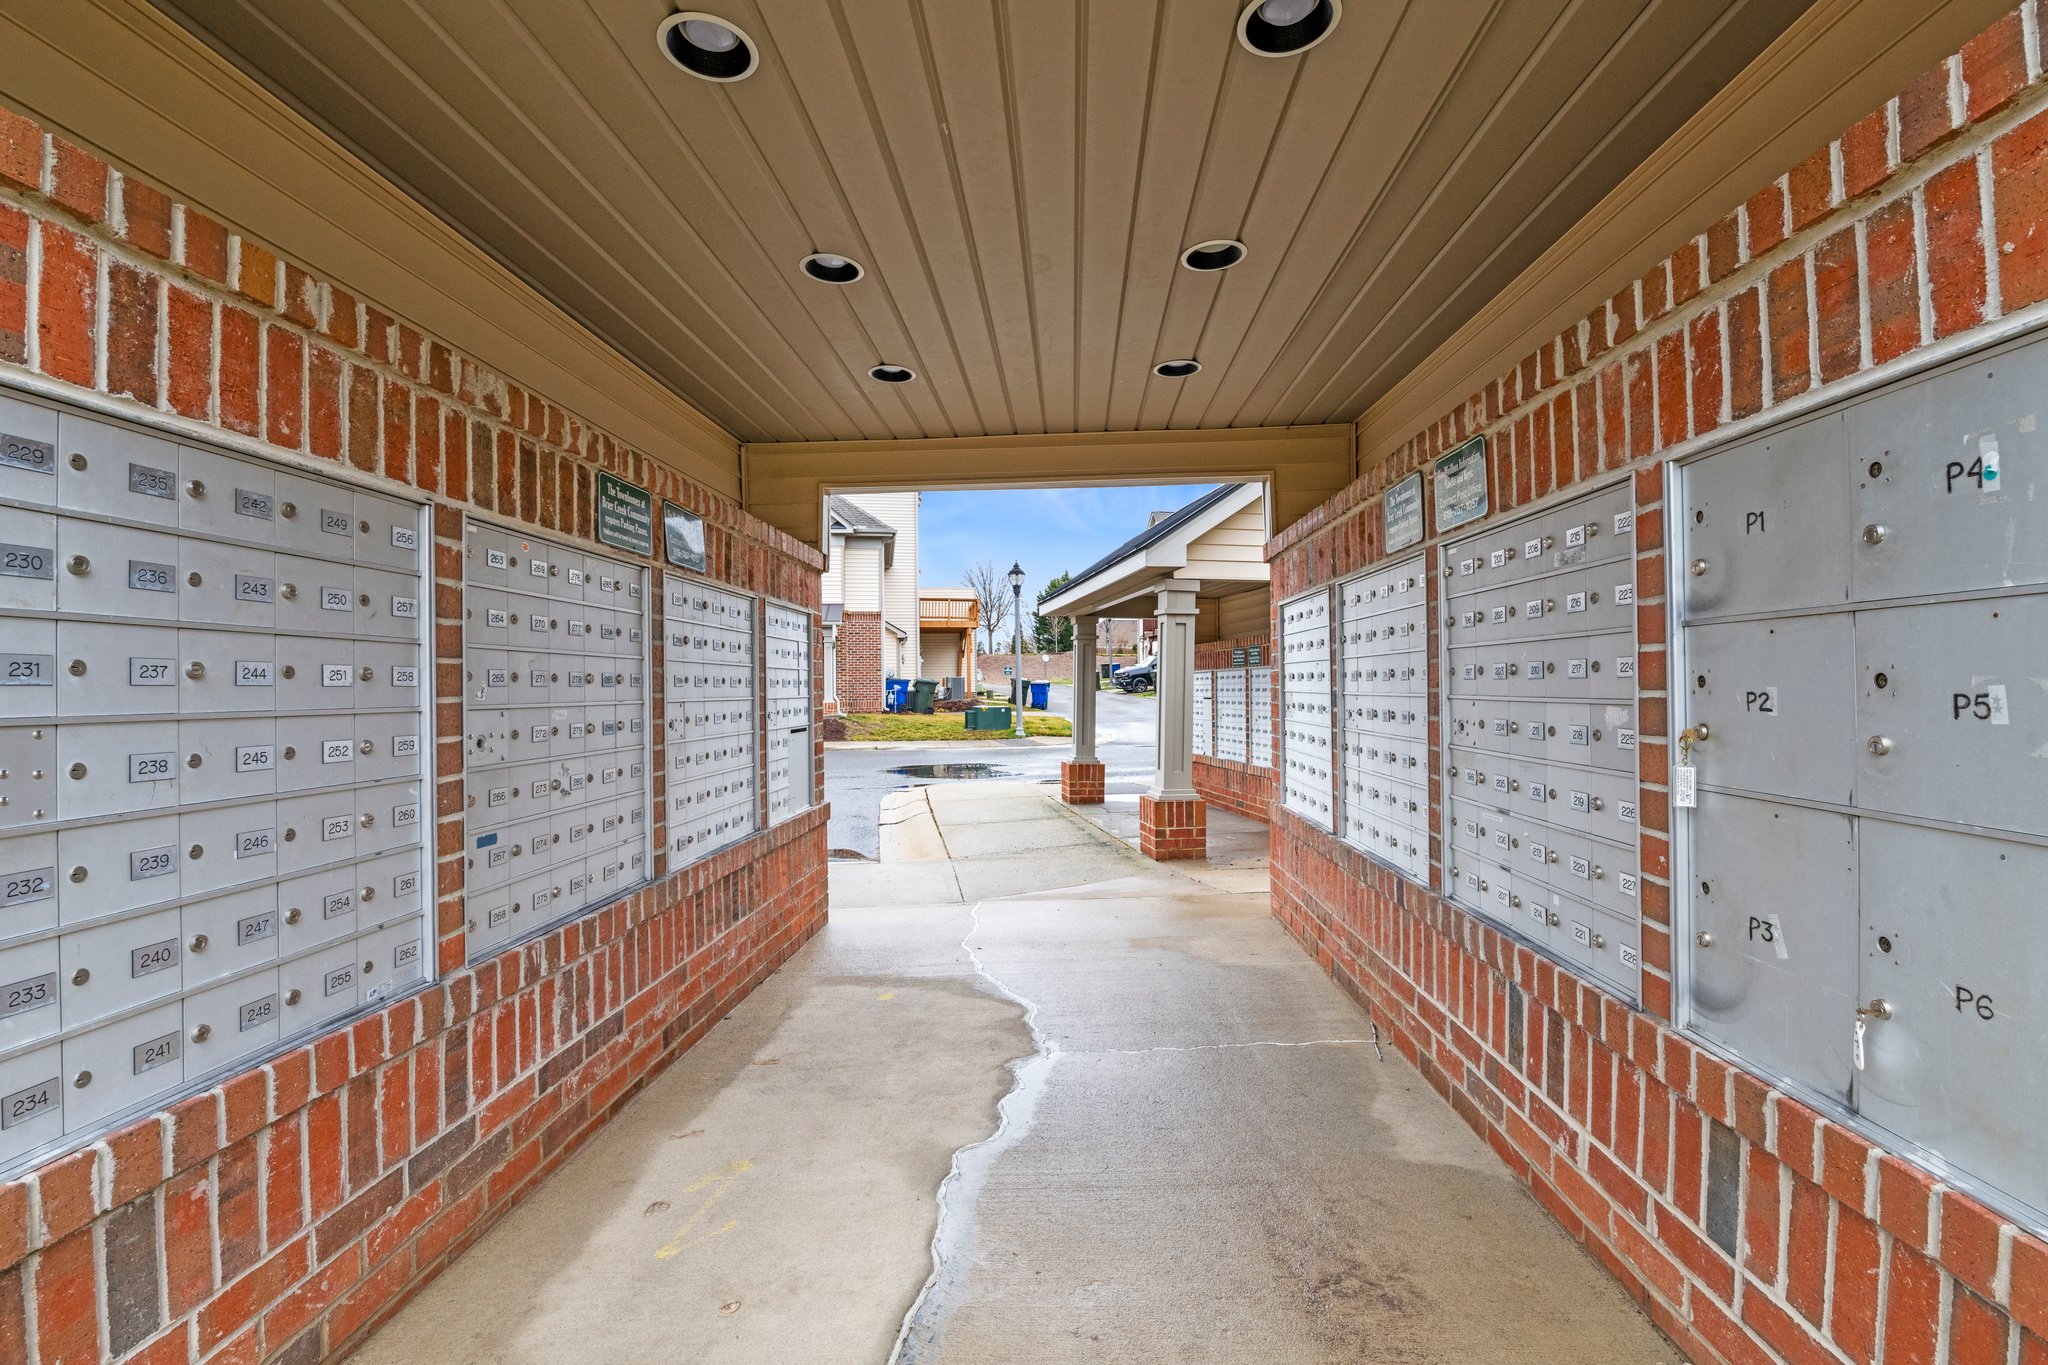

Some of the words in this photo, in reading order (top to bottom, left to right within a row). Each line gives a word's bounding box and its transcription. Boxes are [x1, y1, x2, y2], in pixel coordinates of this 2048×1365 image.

[7, 443, 44, 464] 229
[1947, 456, 1983, 494] P4
[138, 473, 167, 490] 235
[607, 483, 615, 495] The
[1440, 494, 1457, 508] Contact
[1457, 489, 1467, 501] Post
[1467, 483, 1481, 497] Office
[243, 497, 267, 512] 242
[614, 501, 626, 515] Creek
[627, 507, 649, 526] Community
[327, 516, 347, 530] 249
[1618, 516, 1631, 529] 222
[1746, 512, 1765, 534] P1
[396, 531, 414, 544] 256
[1570, 531, 1580, 542] 215
[1528, 544, 1538, 554] 208
[5, 553, 43, 572] 230
[490, 554, 503, 564] 263
[534, 564, 545, 573] 269
[138, 569, 167, 585] 236
[243, 583, 267, 596] 243
[1619, 589, 1632, 600] 223
[328, 594, 347, 606] 250
[1571, 598, 1581, 608] 216
[397, 602, 413, 613] 257
[1529, 605, 1539, 614] 209
[491, 614, 503, 623] 264
[1494, 611, 1503, 619] 202
[535, 620, 545, 628] 270
[572, 624, 581, 632] 277
[9, 662, 40, 678] 231
[139, 666, 168, 679] 237
[1531, 666, 1539, 674] 210
[1572, 664, 1581, 673] 217
[1620, 662, 1633, 672] 224
[243, 668, 267, 680] 244
[329, 670, 347, 681] 251
[397, 671, 414, 682] 258
[492, 674, 504, 682] 265
[1746, 692, 1773, 712] P2
[1953, 693, 1991, 720] P5
[535, 730, 546, 738] 272
[1573, 730, 1583, 740] 218
[1621, 734, 1634, 745] 225
[328, 746, 348, 757] 252
[398, 740, 415, 751] 259
[243, 752, 268, 765] 245
[138, 760, 168, 775] 238
[536, 784, 547, 793] 273
[1532, 787, 1541, 797] 212
[1574, 796, 1584, 807] 219
[398, 809, 416, 821] 260
[1622, 806, 1635, 818] 226
[328, 821, 349, 833] 253
[243, 836, 269, 850] 246
[536, 839, 547, 849] 274
[493, 851, 505, 862] 267
[1533, 848, 1542, 857] 213
[140, 854, 169, 871] 239
[1573, 861, 1585, 873] 220
[7, 878, 44, 898] 232
[400, 877, 416, 890] 261
[574, 880, 583, 889] 282
[1623, 879, 1635, 891] 227
[537, 893, 547, 904] 275
[1498, 891, 1507, 900] 207
[330, 898, 350, 911] 254
[493, 910, 506, 922] 268
[1534, 908, 1542, 918] 214
[245, 920, 269, 938] 247
[1576, 928, 1585, 940] 221
[1750, 916, 1773, 942] P3
[141, 948, 171, 967] 240
[400, 946, 417, 960] 262
[1623, 951, 1636, 965] 228
[331, 972, 352, 986] 255
[9, 985, 46, 1008] 233
[1955, 984, 1994, 1021] P6
[247, 1003, 271, 1022] 248
[145, 1042, 171, 1063] 241
[13, 1091, 49, 1117] 234
